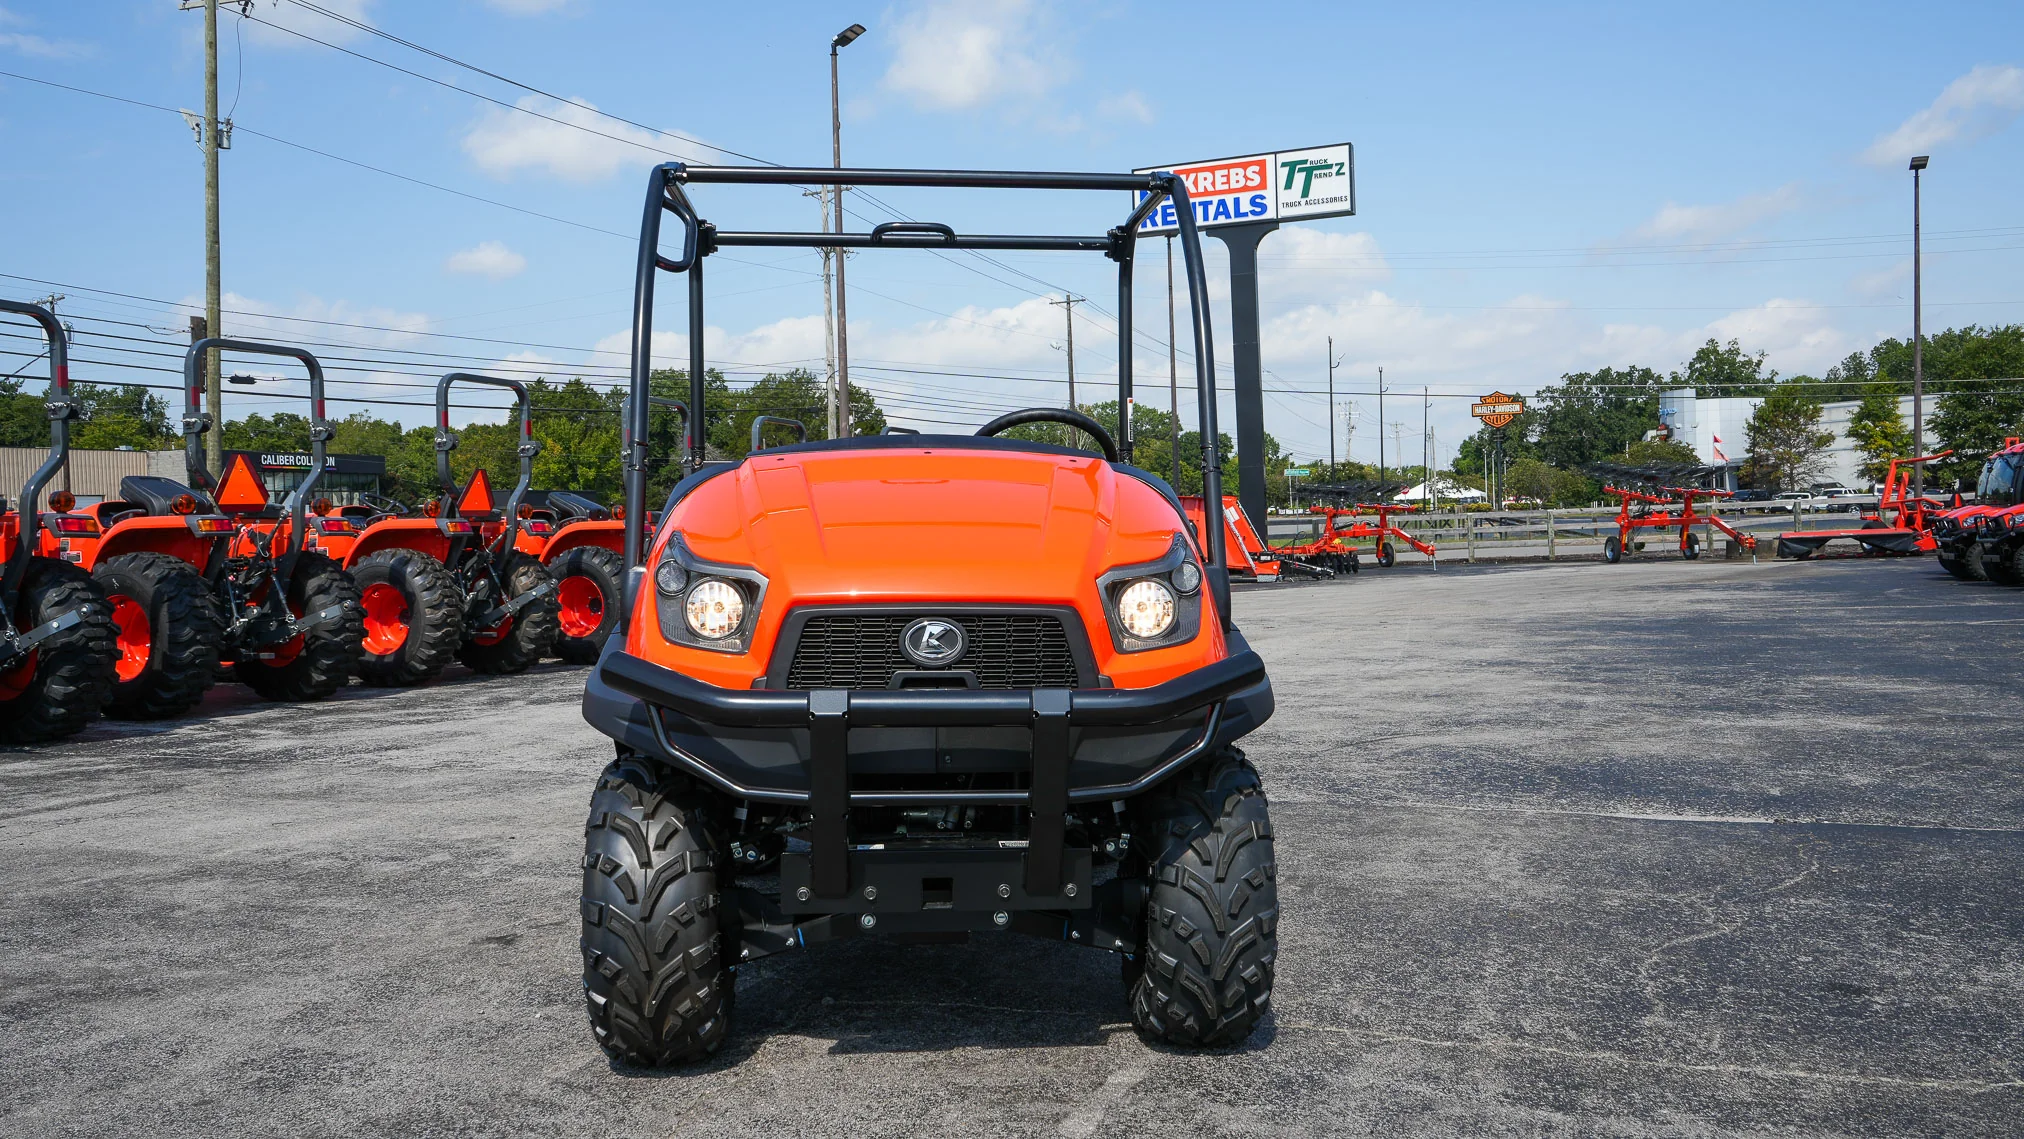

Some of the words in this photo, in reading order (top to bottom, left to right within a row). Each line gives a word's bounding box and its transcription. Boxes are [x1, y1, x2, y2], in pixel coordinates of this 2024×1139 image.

[1180, 165, 1261, 194] KREBS
[1281, 200, 1302, 209] TRUCK
[1304, 195, 1348, 206] ACCESSORIES
[261, 454, 295, 465] CALIBER
